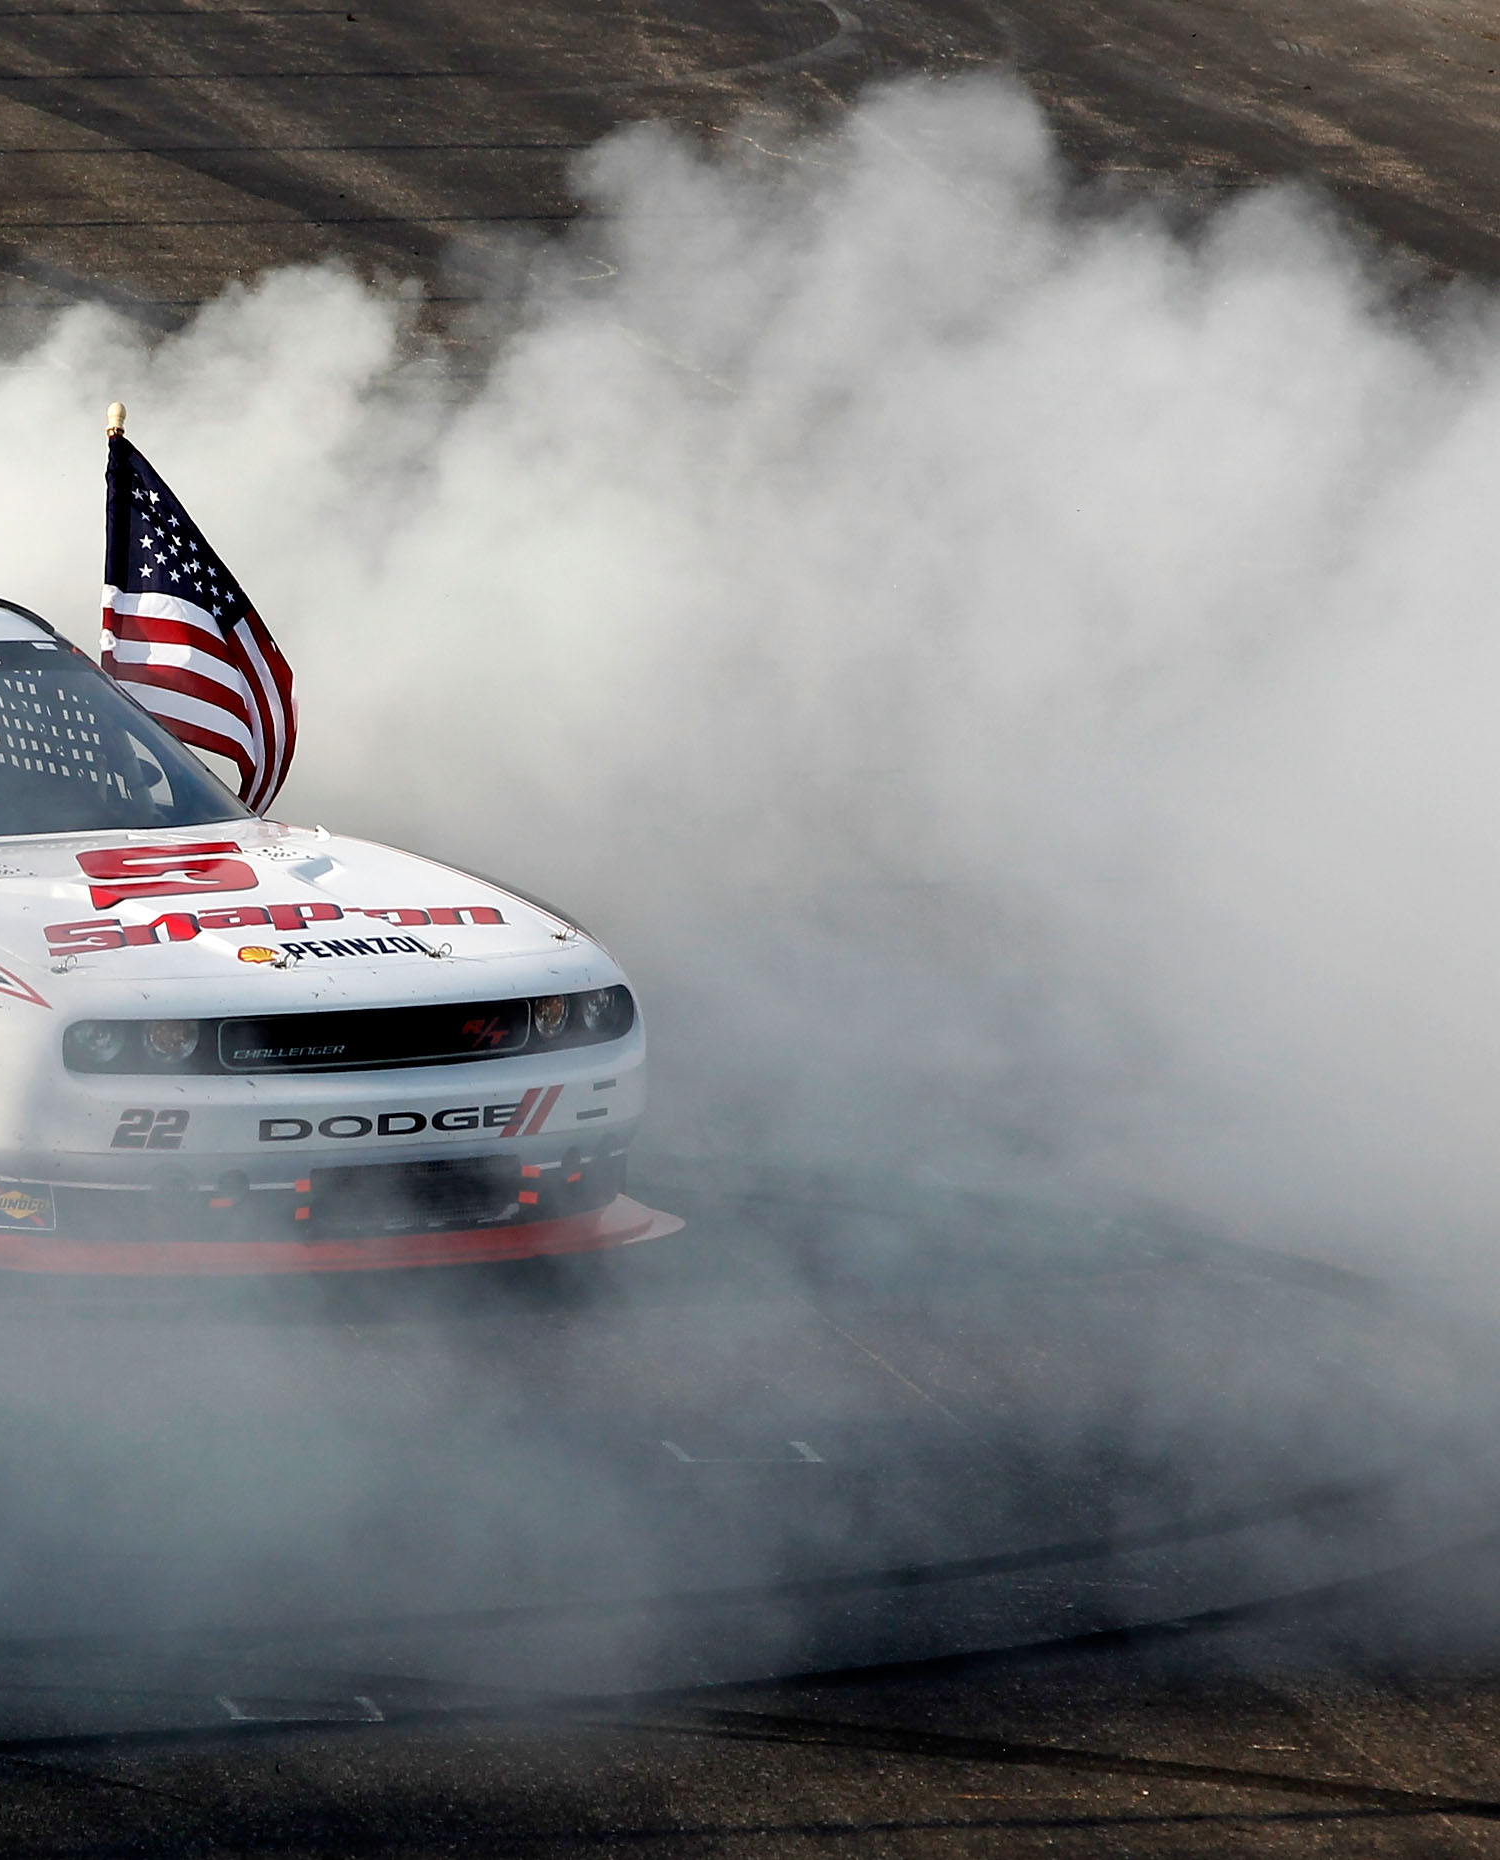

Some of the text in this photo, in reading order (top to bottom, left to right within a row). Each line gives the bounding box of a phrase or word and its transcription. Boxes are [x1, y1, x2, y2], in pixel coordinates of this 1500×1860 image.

[462, 1017, 509, 1047] R/T
[232, 1045, 346, 1060] CHALLENGER
[110, 1108, 190, 1149] 22
[258, 1102, 523, 1142] DODGE
